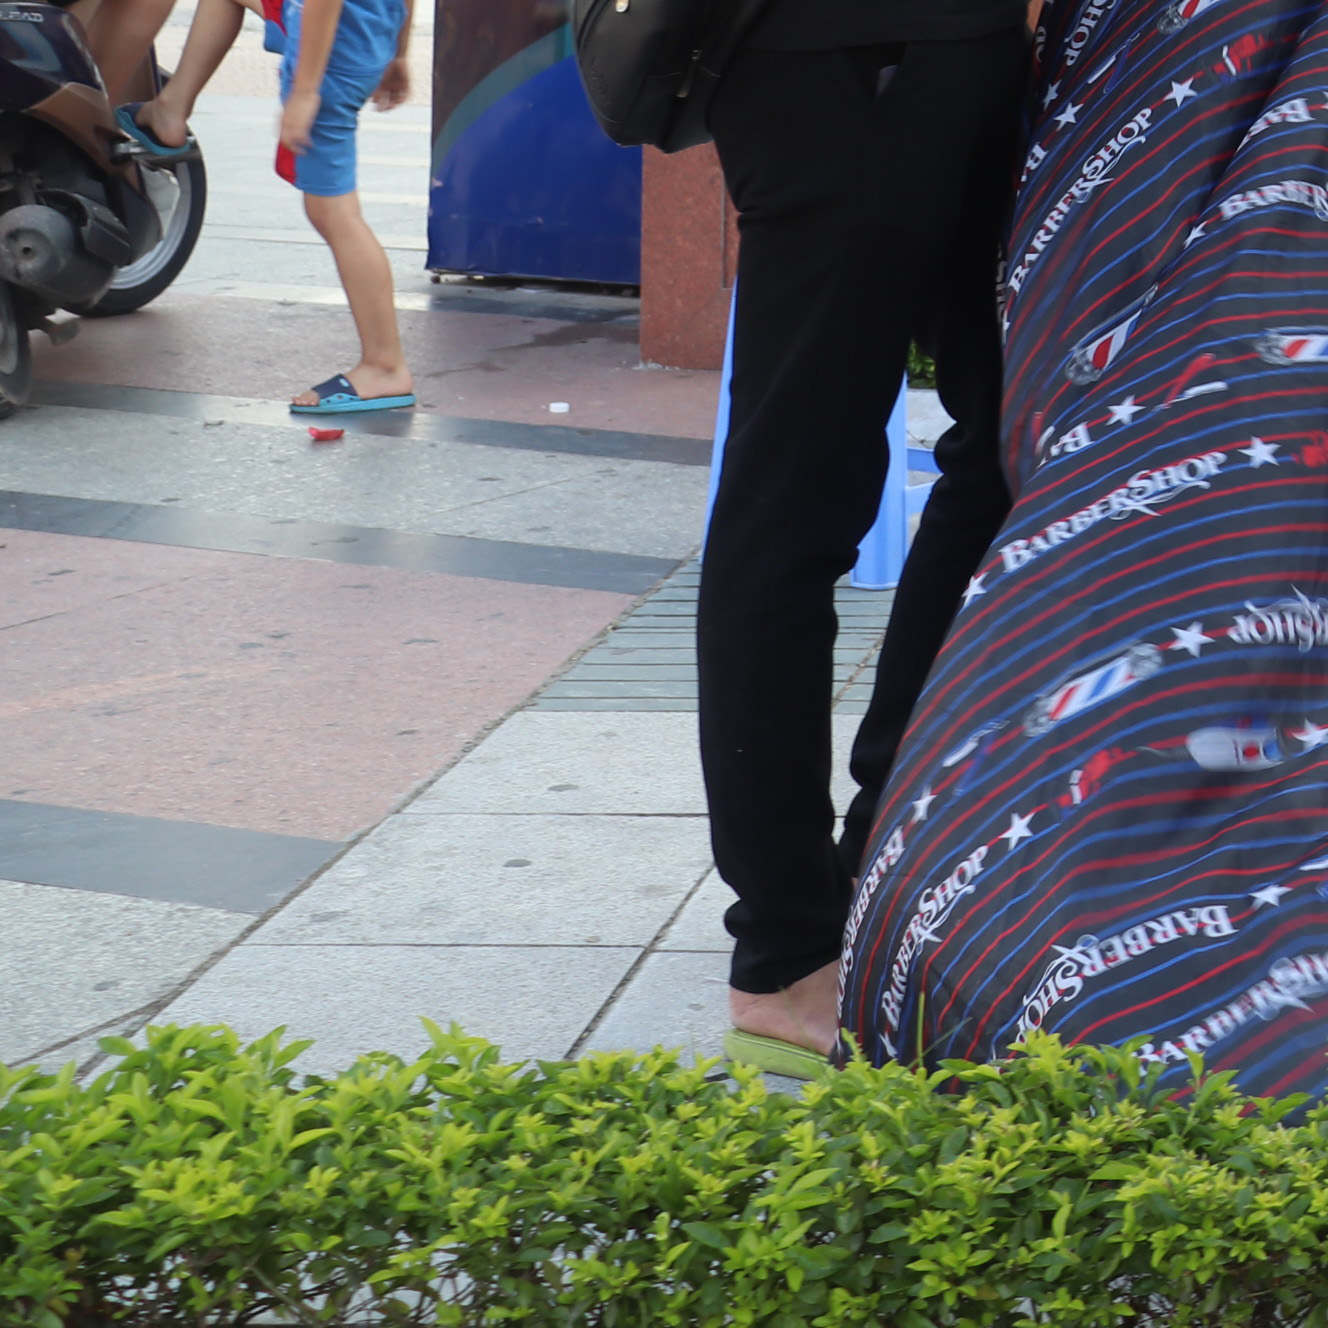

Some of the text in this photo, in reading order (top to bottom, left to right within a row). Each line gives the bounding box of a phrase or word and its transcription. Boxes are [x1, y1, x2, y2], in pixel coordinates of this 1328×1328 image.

[1007, 106, 1154, 297] BARBERSHOP
[997, 450, 1229, 574] BARBERSHOP
[880, 844, 990, 1033] BARBERSHOP
